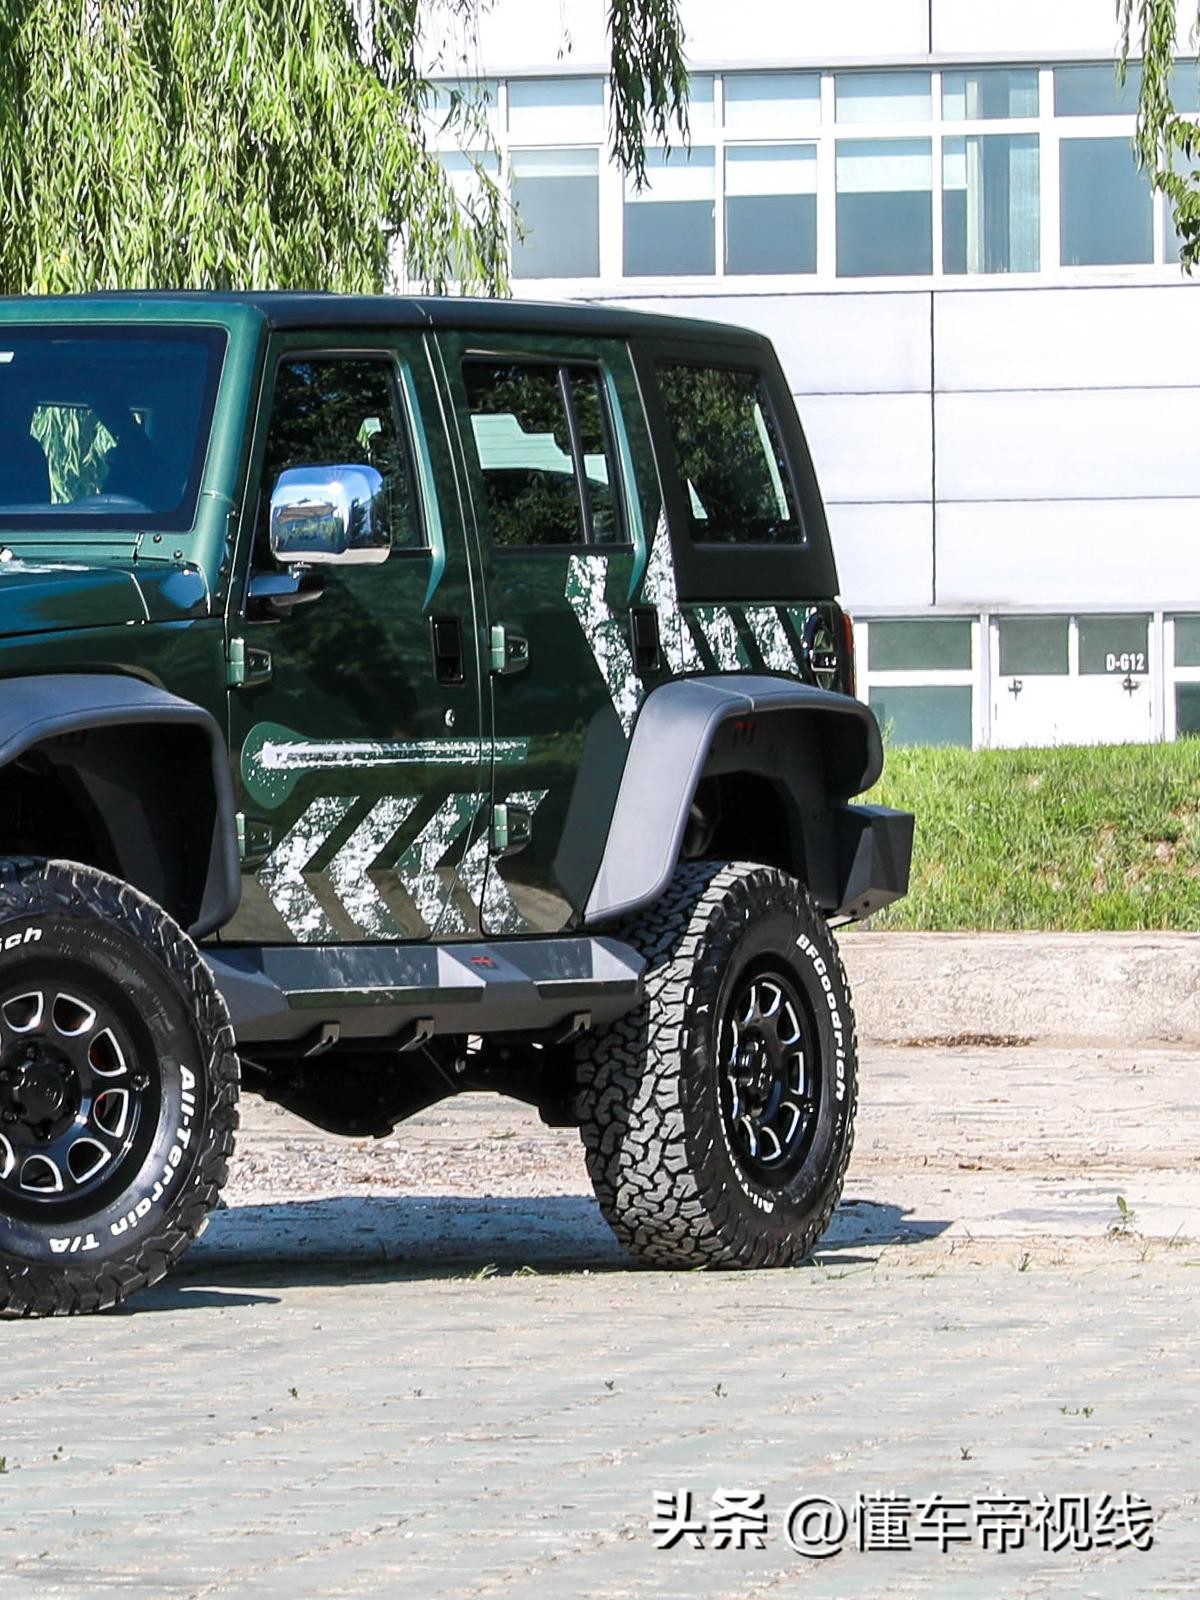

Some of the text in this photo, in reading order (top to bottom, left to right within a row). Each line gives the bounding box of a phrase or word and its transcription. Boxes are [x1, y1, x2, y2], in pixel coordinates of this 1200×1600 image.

[1106, 653, 1145, 671] D-G12
[795, 933, 844, 1101] BFGoodrich
[49, 1064, 196, 1254] All-Terrain T/A
